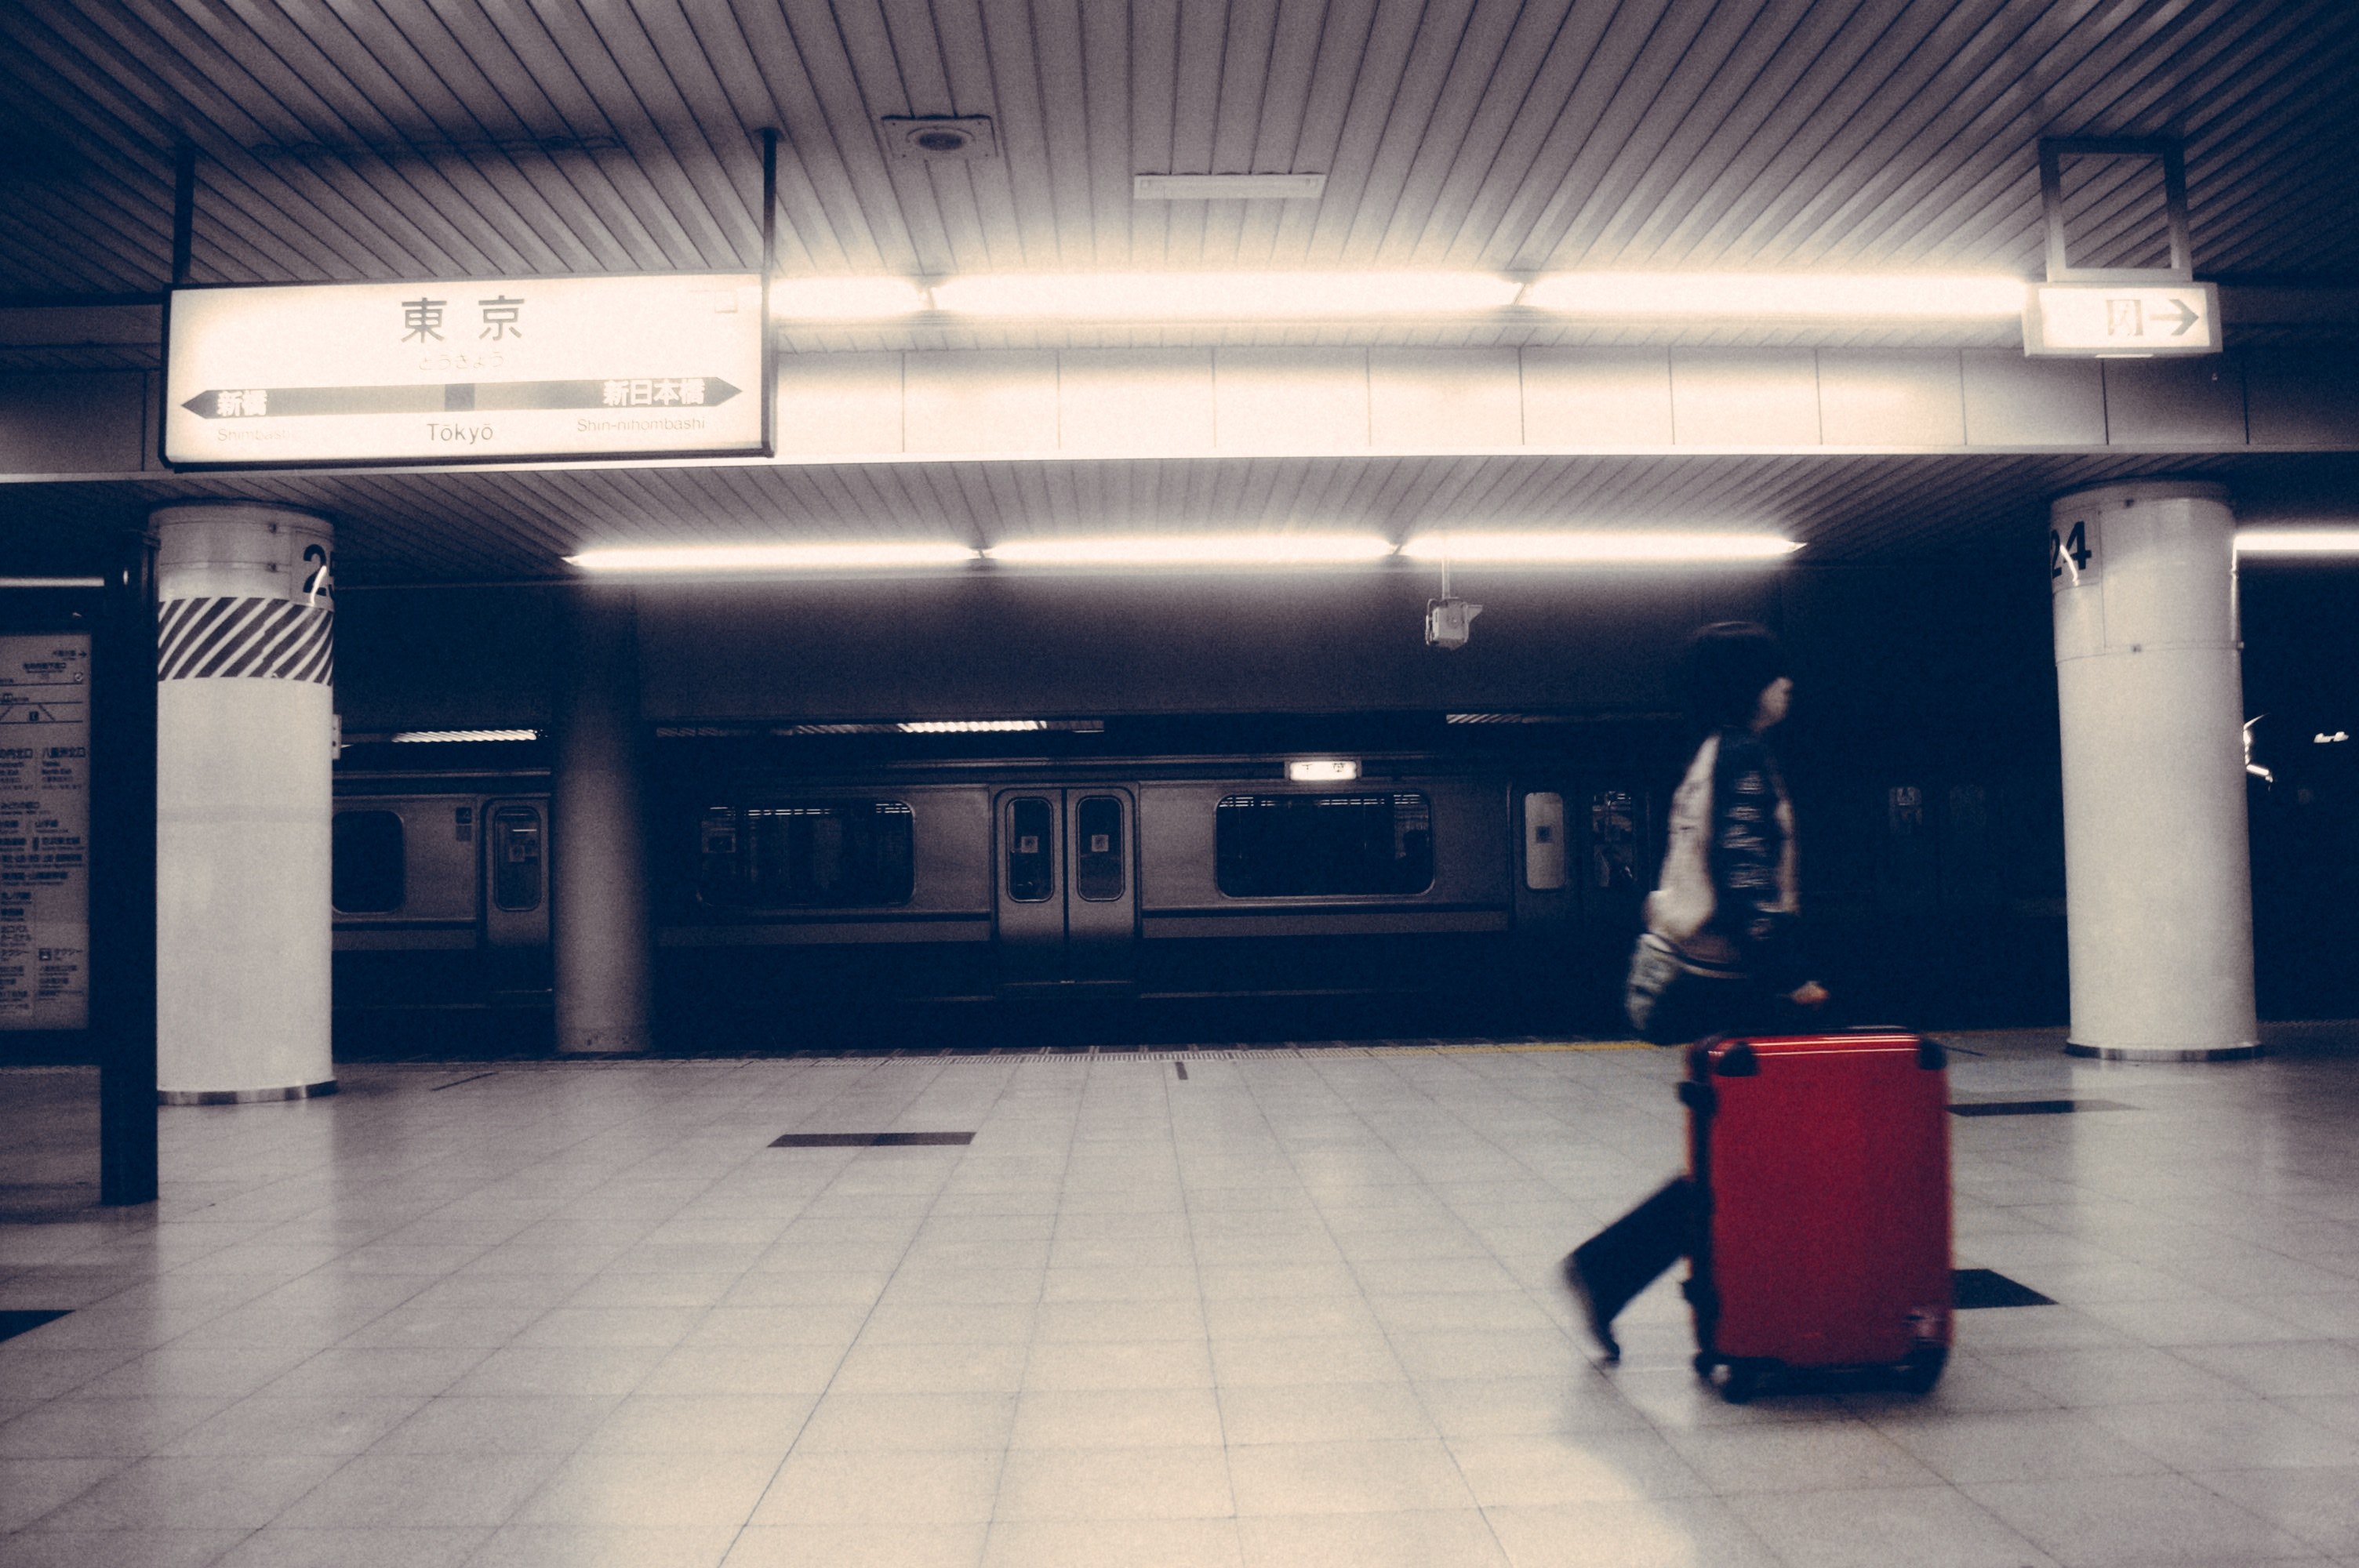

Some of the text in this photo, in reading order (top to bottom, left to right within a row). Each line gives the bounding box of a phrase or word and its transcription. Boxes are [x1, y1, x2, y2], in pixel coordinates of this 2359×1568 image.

[401, 294, 525, 343] 東京
[418, 350, 504, 371] とうきょう
[217, 389, 267, 417] 新橋
[603, 378, 706, 407] 新日本橋
[426, 423, 493, 445] Tōkyō
[576, 416, 706, 433] Shin-nihombashi
[2051, 521, 2092, 579] 24
